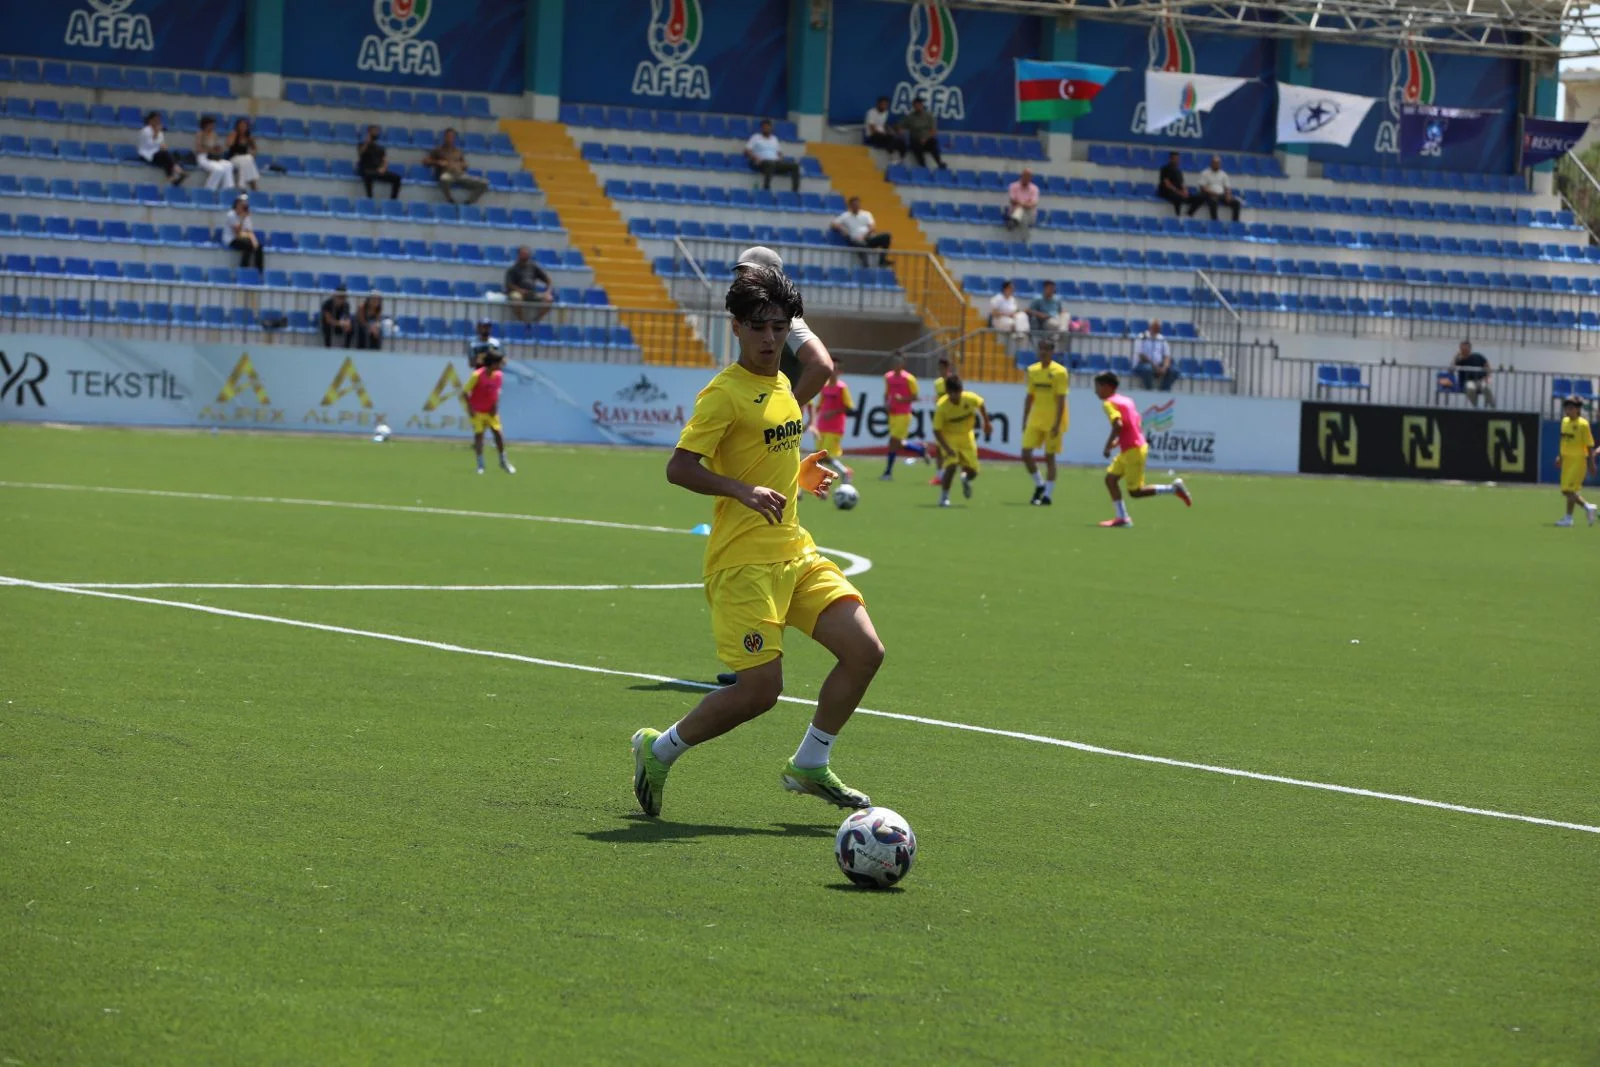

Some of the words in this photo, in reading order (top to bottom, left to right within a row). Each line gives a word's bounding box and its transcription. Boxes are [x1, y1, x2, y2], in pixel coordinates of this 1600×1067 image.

[64, 9, 154, 51] AFFA
[357, 35, 441, 76] AFFA
[631, 61, 711, 99] AFFA
